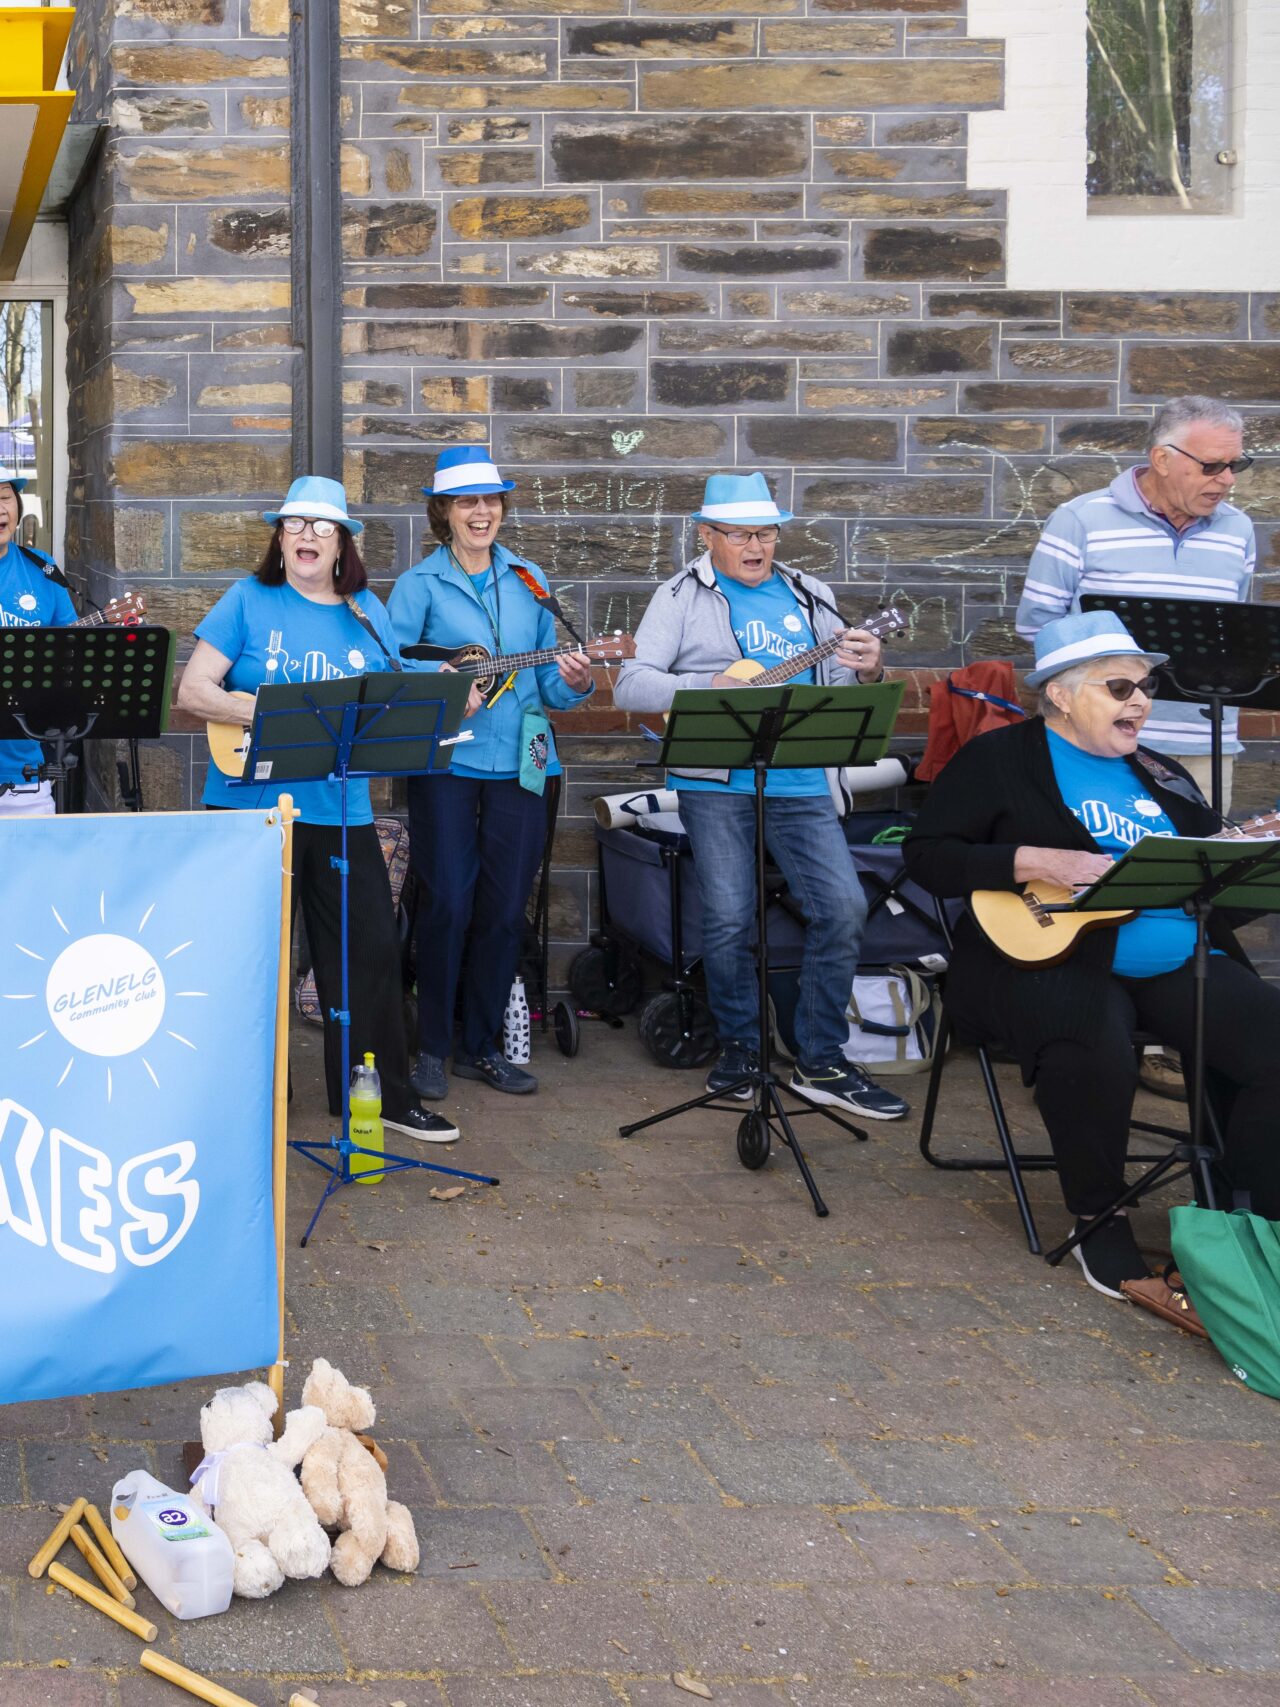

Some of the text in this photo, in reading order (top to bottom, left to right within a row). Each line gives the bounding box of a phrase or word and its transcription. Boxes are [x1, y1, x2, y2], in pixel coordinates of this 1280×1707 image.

[53, 966, 157, 1013] GLENELG
[69, 988, 157, 1022] Community Club
[160, 1511, 186, 1523] a2
